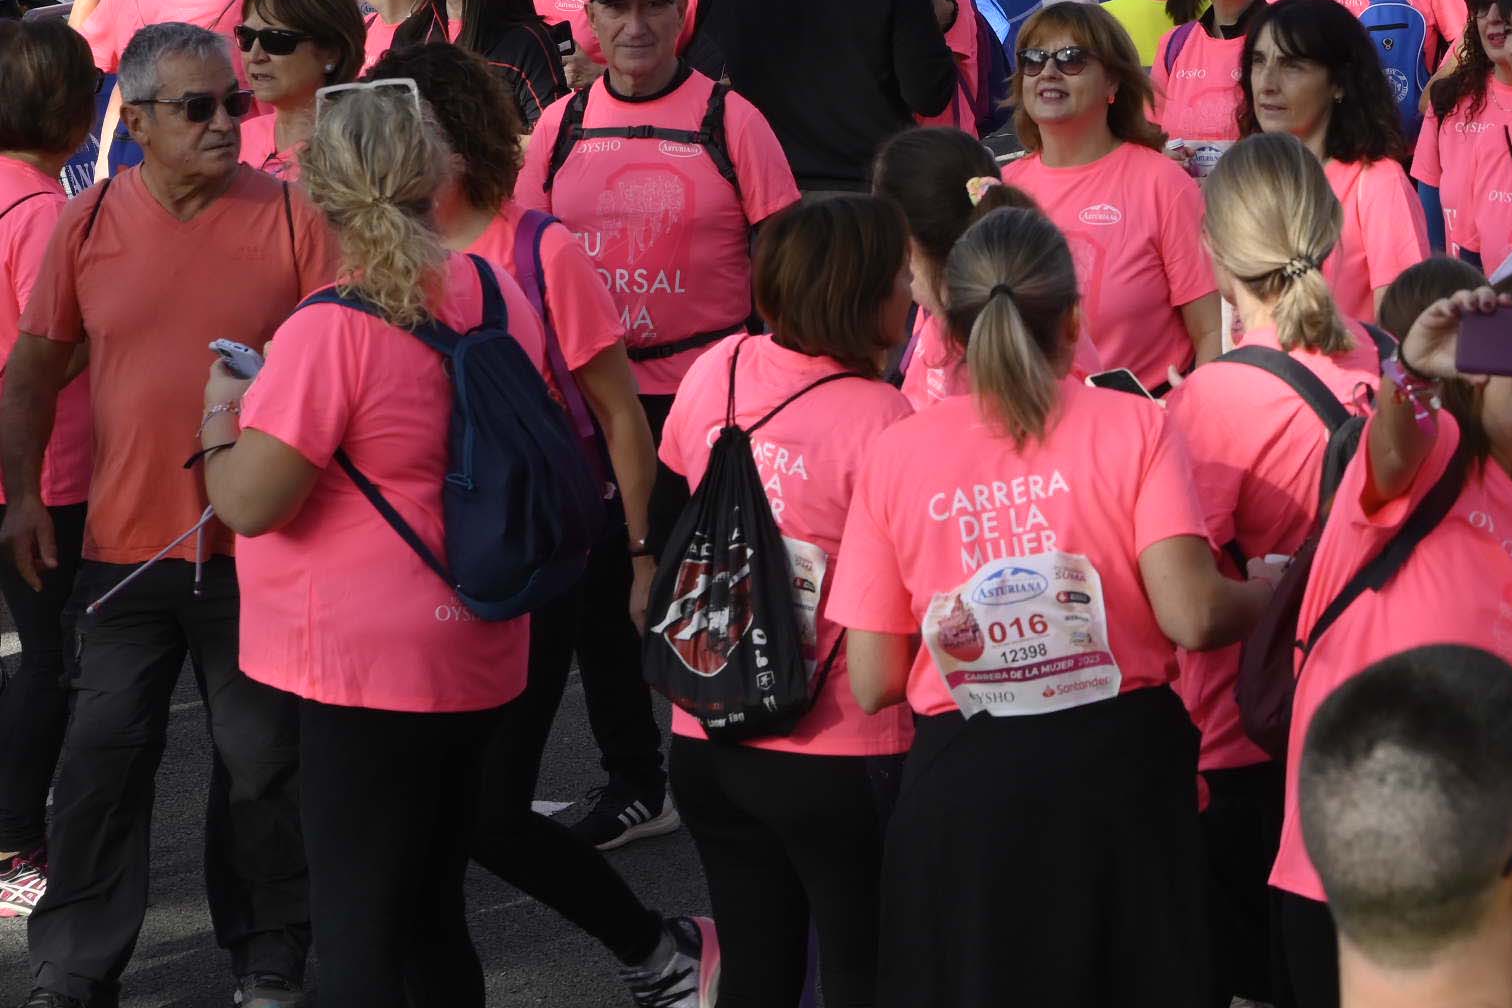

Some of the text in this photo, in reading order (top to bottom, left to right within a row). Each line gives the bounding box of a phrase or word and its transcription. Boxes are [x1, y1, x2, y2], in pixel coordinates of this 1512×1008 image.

[597, 268, 686, 294] ORSAL
[928, 470, 1070, 523] CARRERA
[958, 505, 1049, 544] DE LA
[979, 581, 1044, 600] ASTURIANA
[434, 604, 474, 622] OYS
[988, 612, 1049, 644] 016
[1000, 642, 1048, 664] 12398
[964, 671, 1009, 681] CARRERA
[1010, 670, 1024, 679] DE
[1025, 668, 1040, 678] LA
[1040, 660, 1074, 674] MUJER
[1056, 677, 1111, 696] Santander
